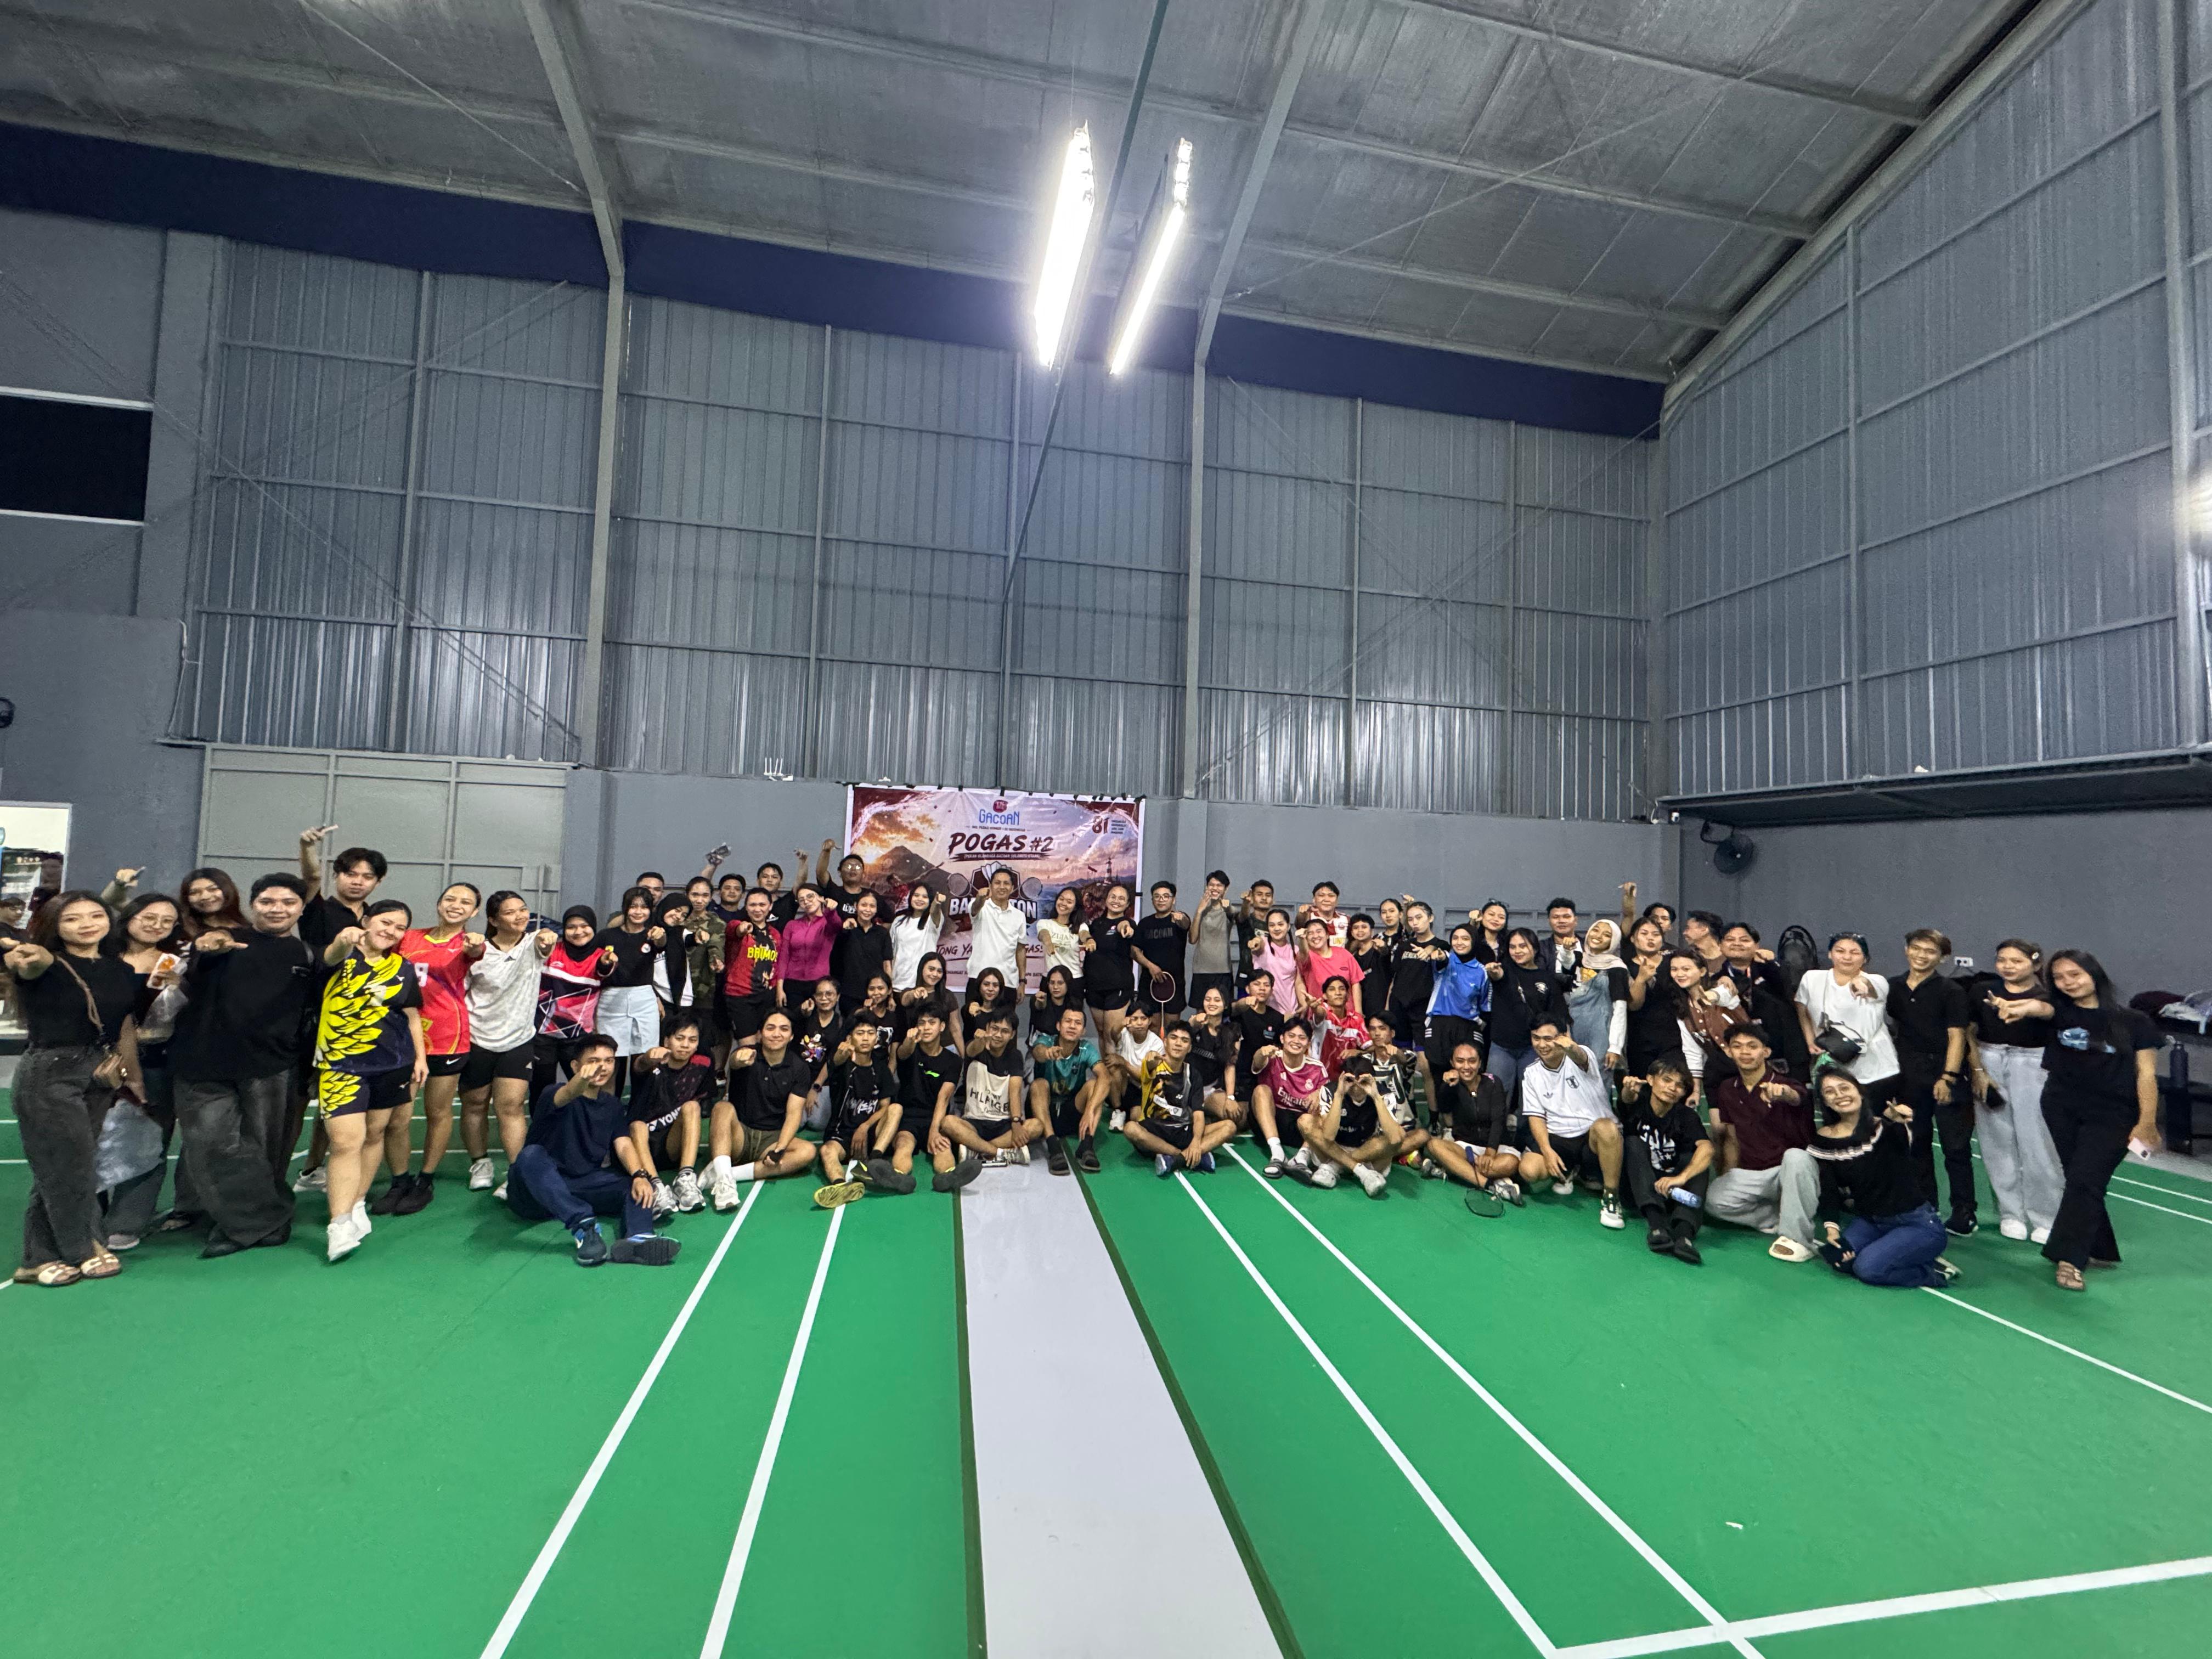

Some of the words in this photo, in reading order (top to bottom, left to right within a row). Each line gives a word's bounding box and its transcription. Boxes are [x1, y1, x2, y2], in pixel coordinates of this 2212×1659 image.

[979, 809, 1020, 826] GACOAN
[948, 832, 1028, 856] POGAS
[1029, 836, 1054, 852] #2
[949, 898, 1037, 919] BATON
[658, 1106, 682, 1126] YON
